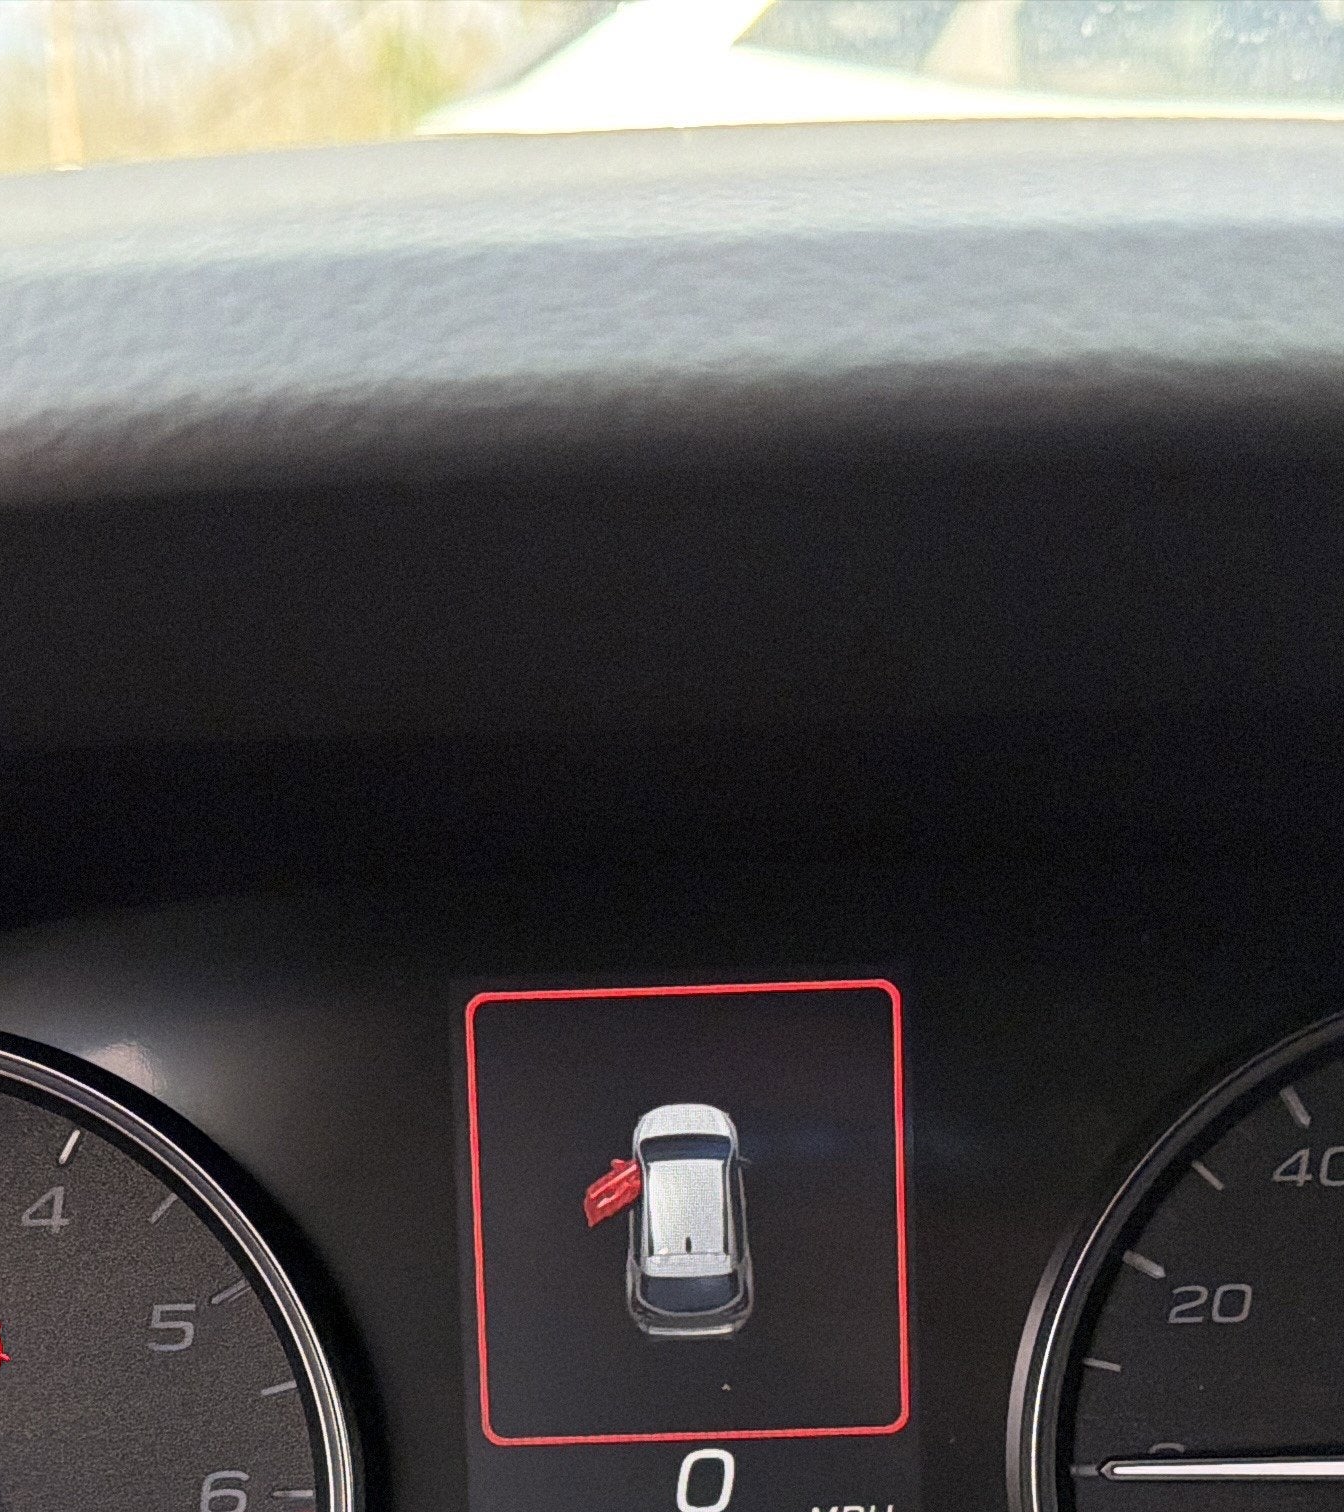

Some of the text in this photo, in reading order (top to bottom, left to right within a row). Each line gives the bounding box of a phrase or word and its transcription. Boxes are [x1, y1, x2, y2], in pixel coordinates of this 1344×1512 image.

[21, 1186, 70, 1234] 4
[148, 1303, 196, 1352] 5
[1168, 1283, 1253, 1324] 20
